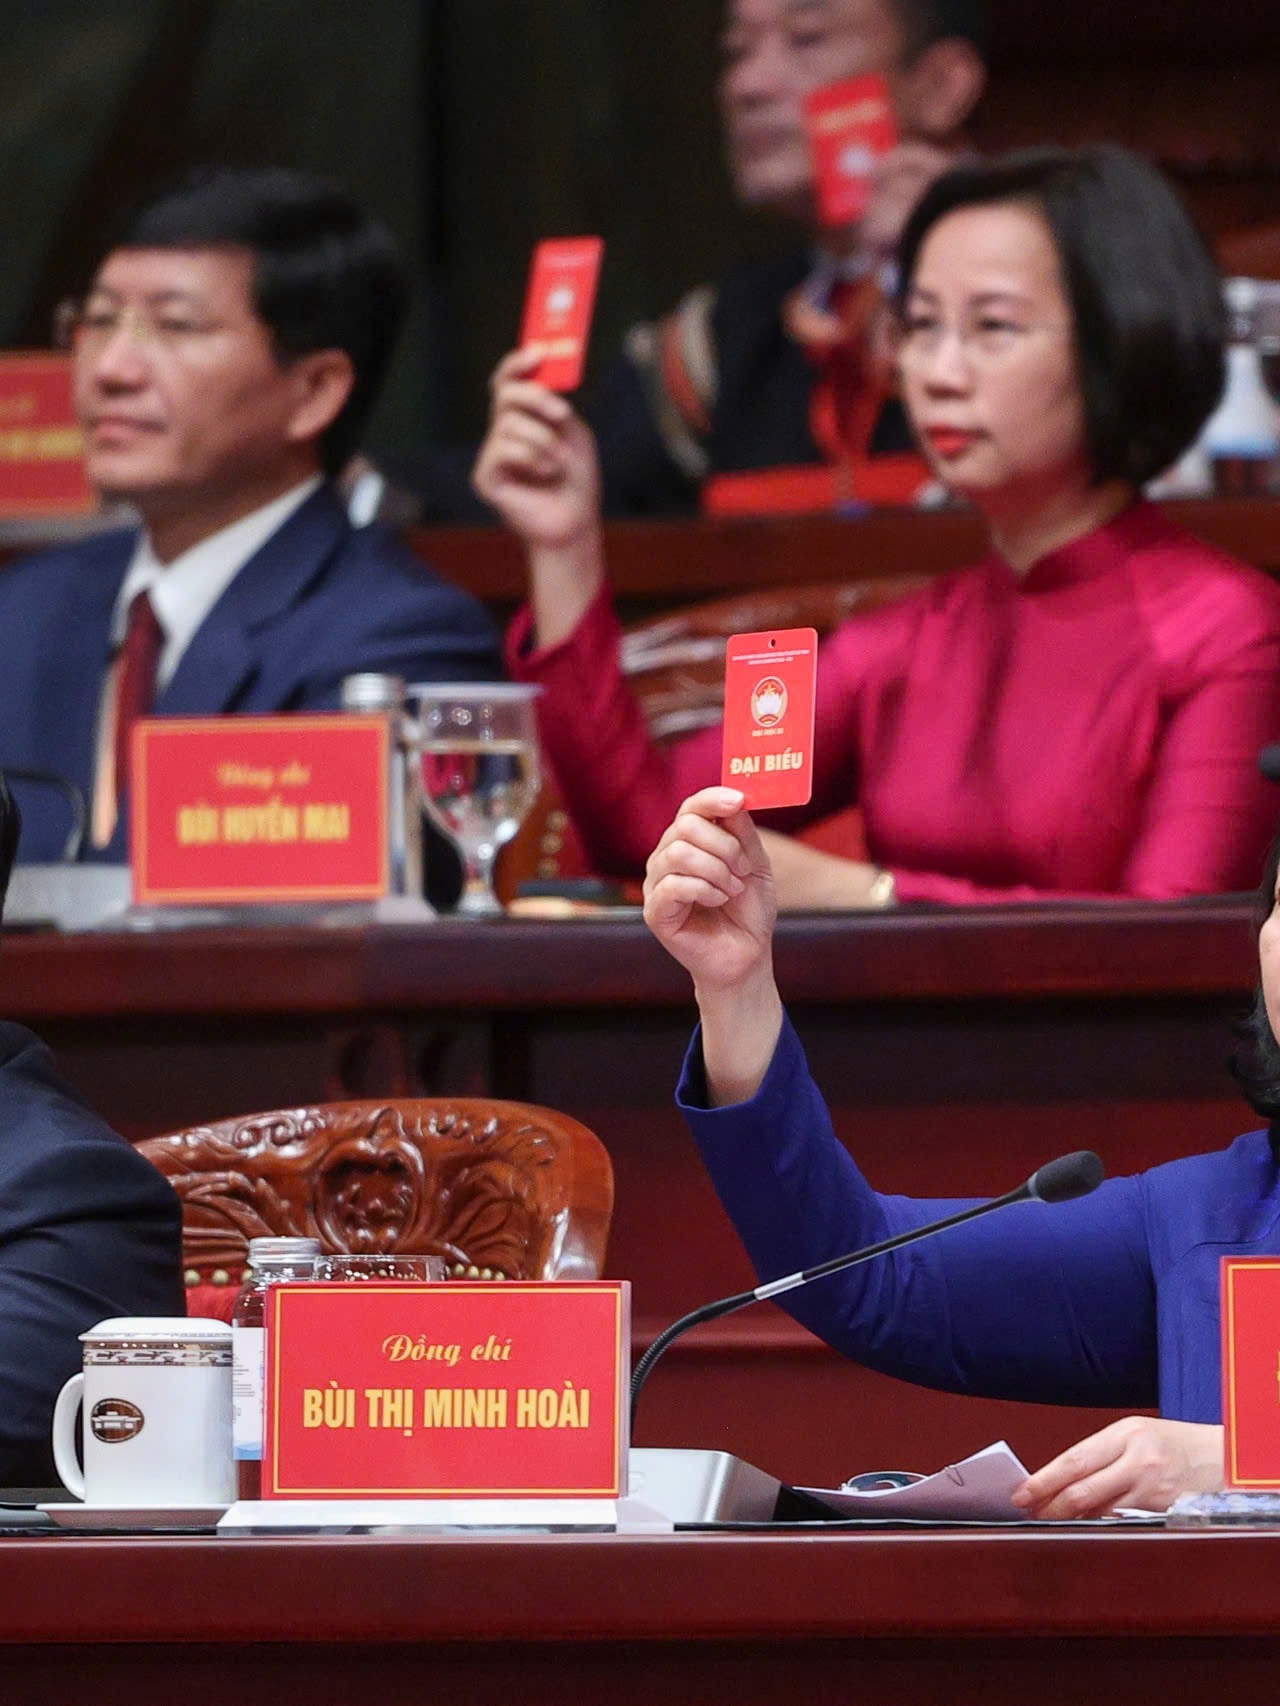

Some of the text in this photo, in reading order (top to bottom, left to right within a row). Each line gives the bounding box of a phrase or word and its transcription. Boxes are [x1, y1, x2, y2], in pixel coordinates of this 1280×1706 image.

[382, 1334, 513, 1367] Đồng chí
[303, 1380, 591, 1437] BÙI THỊ MINH HOÀI
